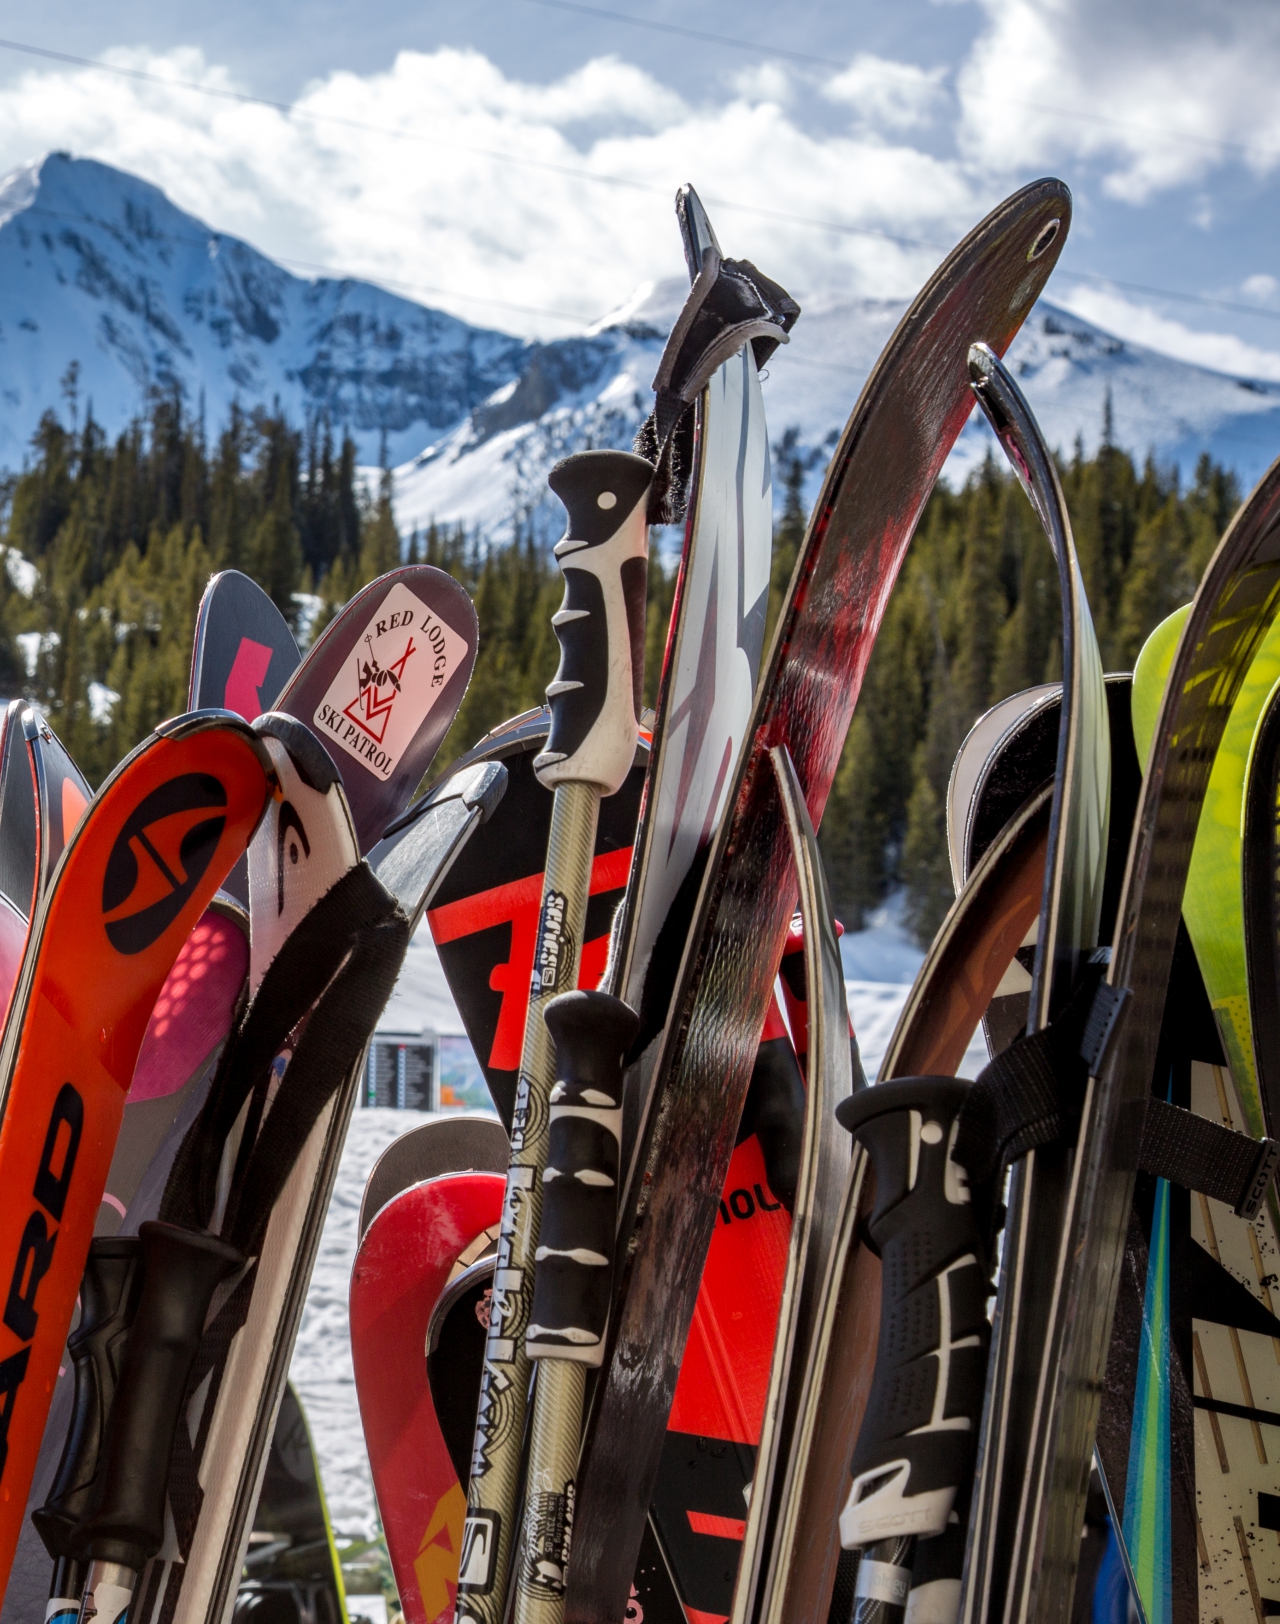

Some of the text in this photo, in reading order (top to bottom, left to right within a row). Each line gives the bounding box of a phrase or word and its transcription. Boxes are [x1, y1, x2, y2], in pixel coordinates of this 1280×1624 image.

[375, 610, 447, 688] RED LODGE
[317, 704, 394, 776] SKI PATROL
[1245, 1146, 1277, 1215] SCOTT
